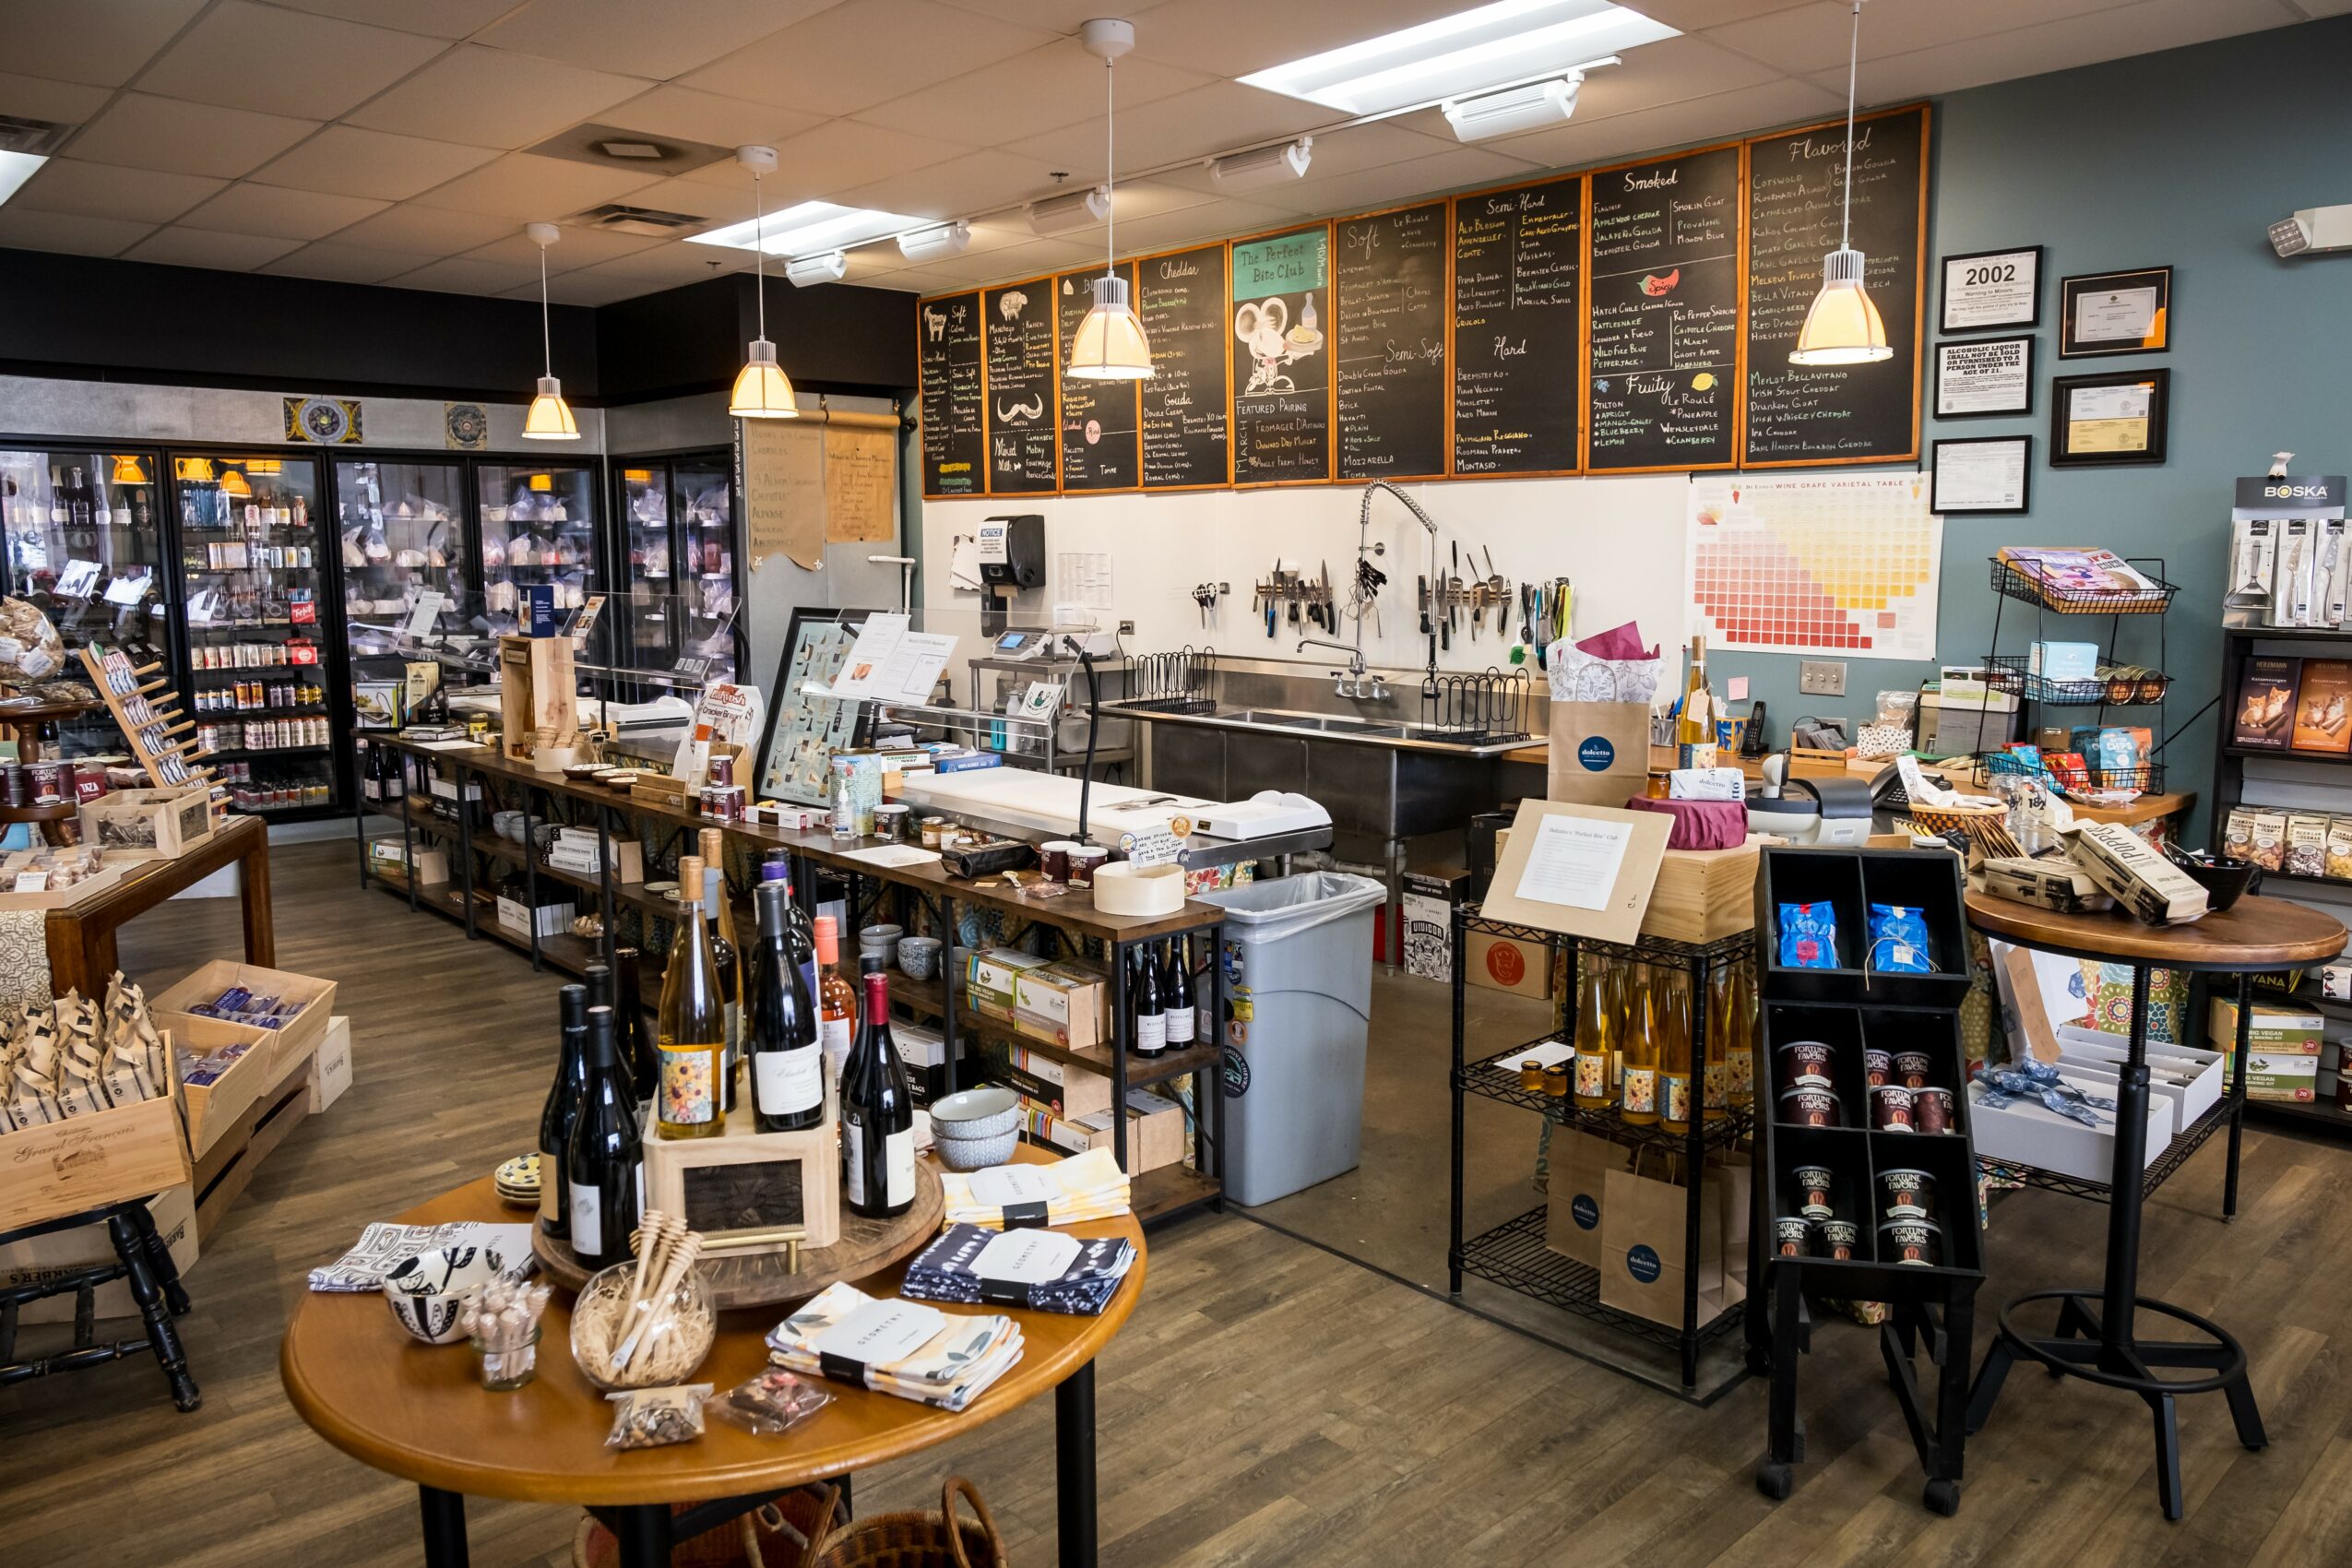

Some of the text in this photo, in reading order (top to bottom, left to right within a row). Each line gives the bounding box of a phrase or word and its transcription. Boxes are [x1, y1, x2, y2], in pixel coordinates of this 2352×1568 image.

[1623, 170, 1678, 192] Smoked
[1348, 225, 1380, 260] Soft
[1241, 244, 1304, 266] The Perfect
[1160, 262, 1199, 280] Cheddar
[1253, 262, 1305, 282] Bite Club
[1550, 262, 1574, 273] CLASSIC
[1966, 264, 2014, 286] 2002
[1649, 280, 1673, 295] Spicy
[1551, 295, 1571, 304] SWISS
[952, 305, 967, 324] Soft
[1592, 306, 1616, 317] HATCH
[1385, 338, 1444, 365] Semi-Soft
[1494, 336, 1526, 361] Hard
[1631, 344, 1647, 352] BLUE
[1959, 357, 2002, 365] FURNISHED
[1384, 365, 1407, 374] GOUDA
[1338, 386, 1361, 395] FONTINA
[1625, 374, 1675, 406] Fruity
[1776, 386, 1800, 396] STOUT
[1164, 392, 1193, 406] Gouda
[1594, 398, 1623, 410] STILTON
[1792, 398, 1818, 408] GOAT
[1236, 397, 1307, 416] FEATURED PAIRING
[1677, 409, 1718, 419] PINEAPPLE
[1256, 421, 1294, 434] FROMAGER
[1671, 435, 1715, 445] CRANBERRY
[995, 437, 1016, 457] Mixed
[1236, 421, 1247, 472] MARCH
[998, 459, 1013, 472] Milk
[1344, 456, 1394, 467] MOZZARELLA
[1457, 459, 1496, 471] MONTASIO
[2264, 485, 2327, 498] BOSKA
[981, 529, 1002, 537] NOTICE
[703, 707, 723, 716] Cracker
[79, 782, 99, 792] TAZA
[1699, 778, 1725, 788] dolcetto
[2232, 972, 2285, 987] MYANA
[1795, 1046, 1828, 1057] FORTUNE
[1798, 1051, 1826, 1062] FAVORS
[911, 1085, 924, 1093] BAGS
[1798, 1095, 1832, 1105] FORTUNE
[1802, 1099, 1830, 1111] FAVORS
[13, 1139, 65, 1163] Grand
[1885, 1174, 1920, 1184] FORTUNE
[1889, 1180, 1918, 1190] FAVORS
[1574, 1205, 1596, 1217] dolcetto
[1892, 1228, 1928, 1238] FORTUNE
[1895, 1233, 1926, 1244] FAVORS
[1013, 1241, 1039, 1269] GEOMETRY
[1631, 1256, 1657, 1268] dolcetto
[858, 1313, 902, 1345] GEOMETRY
